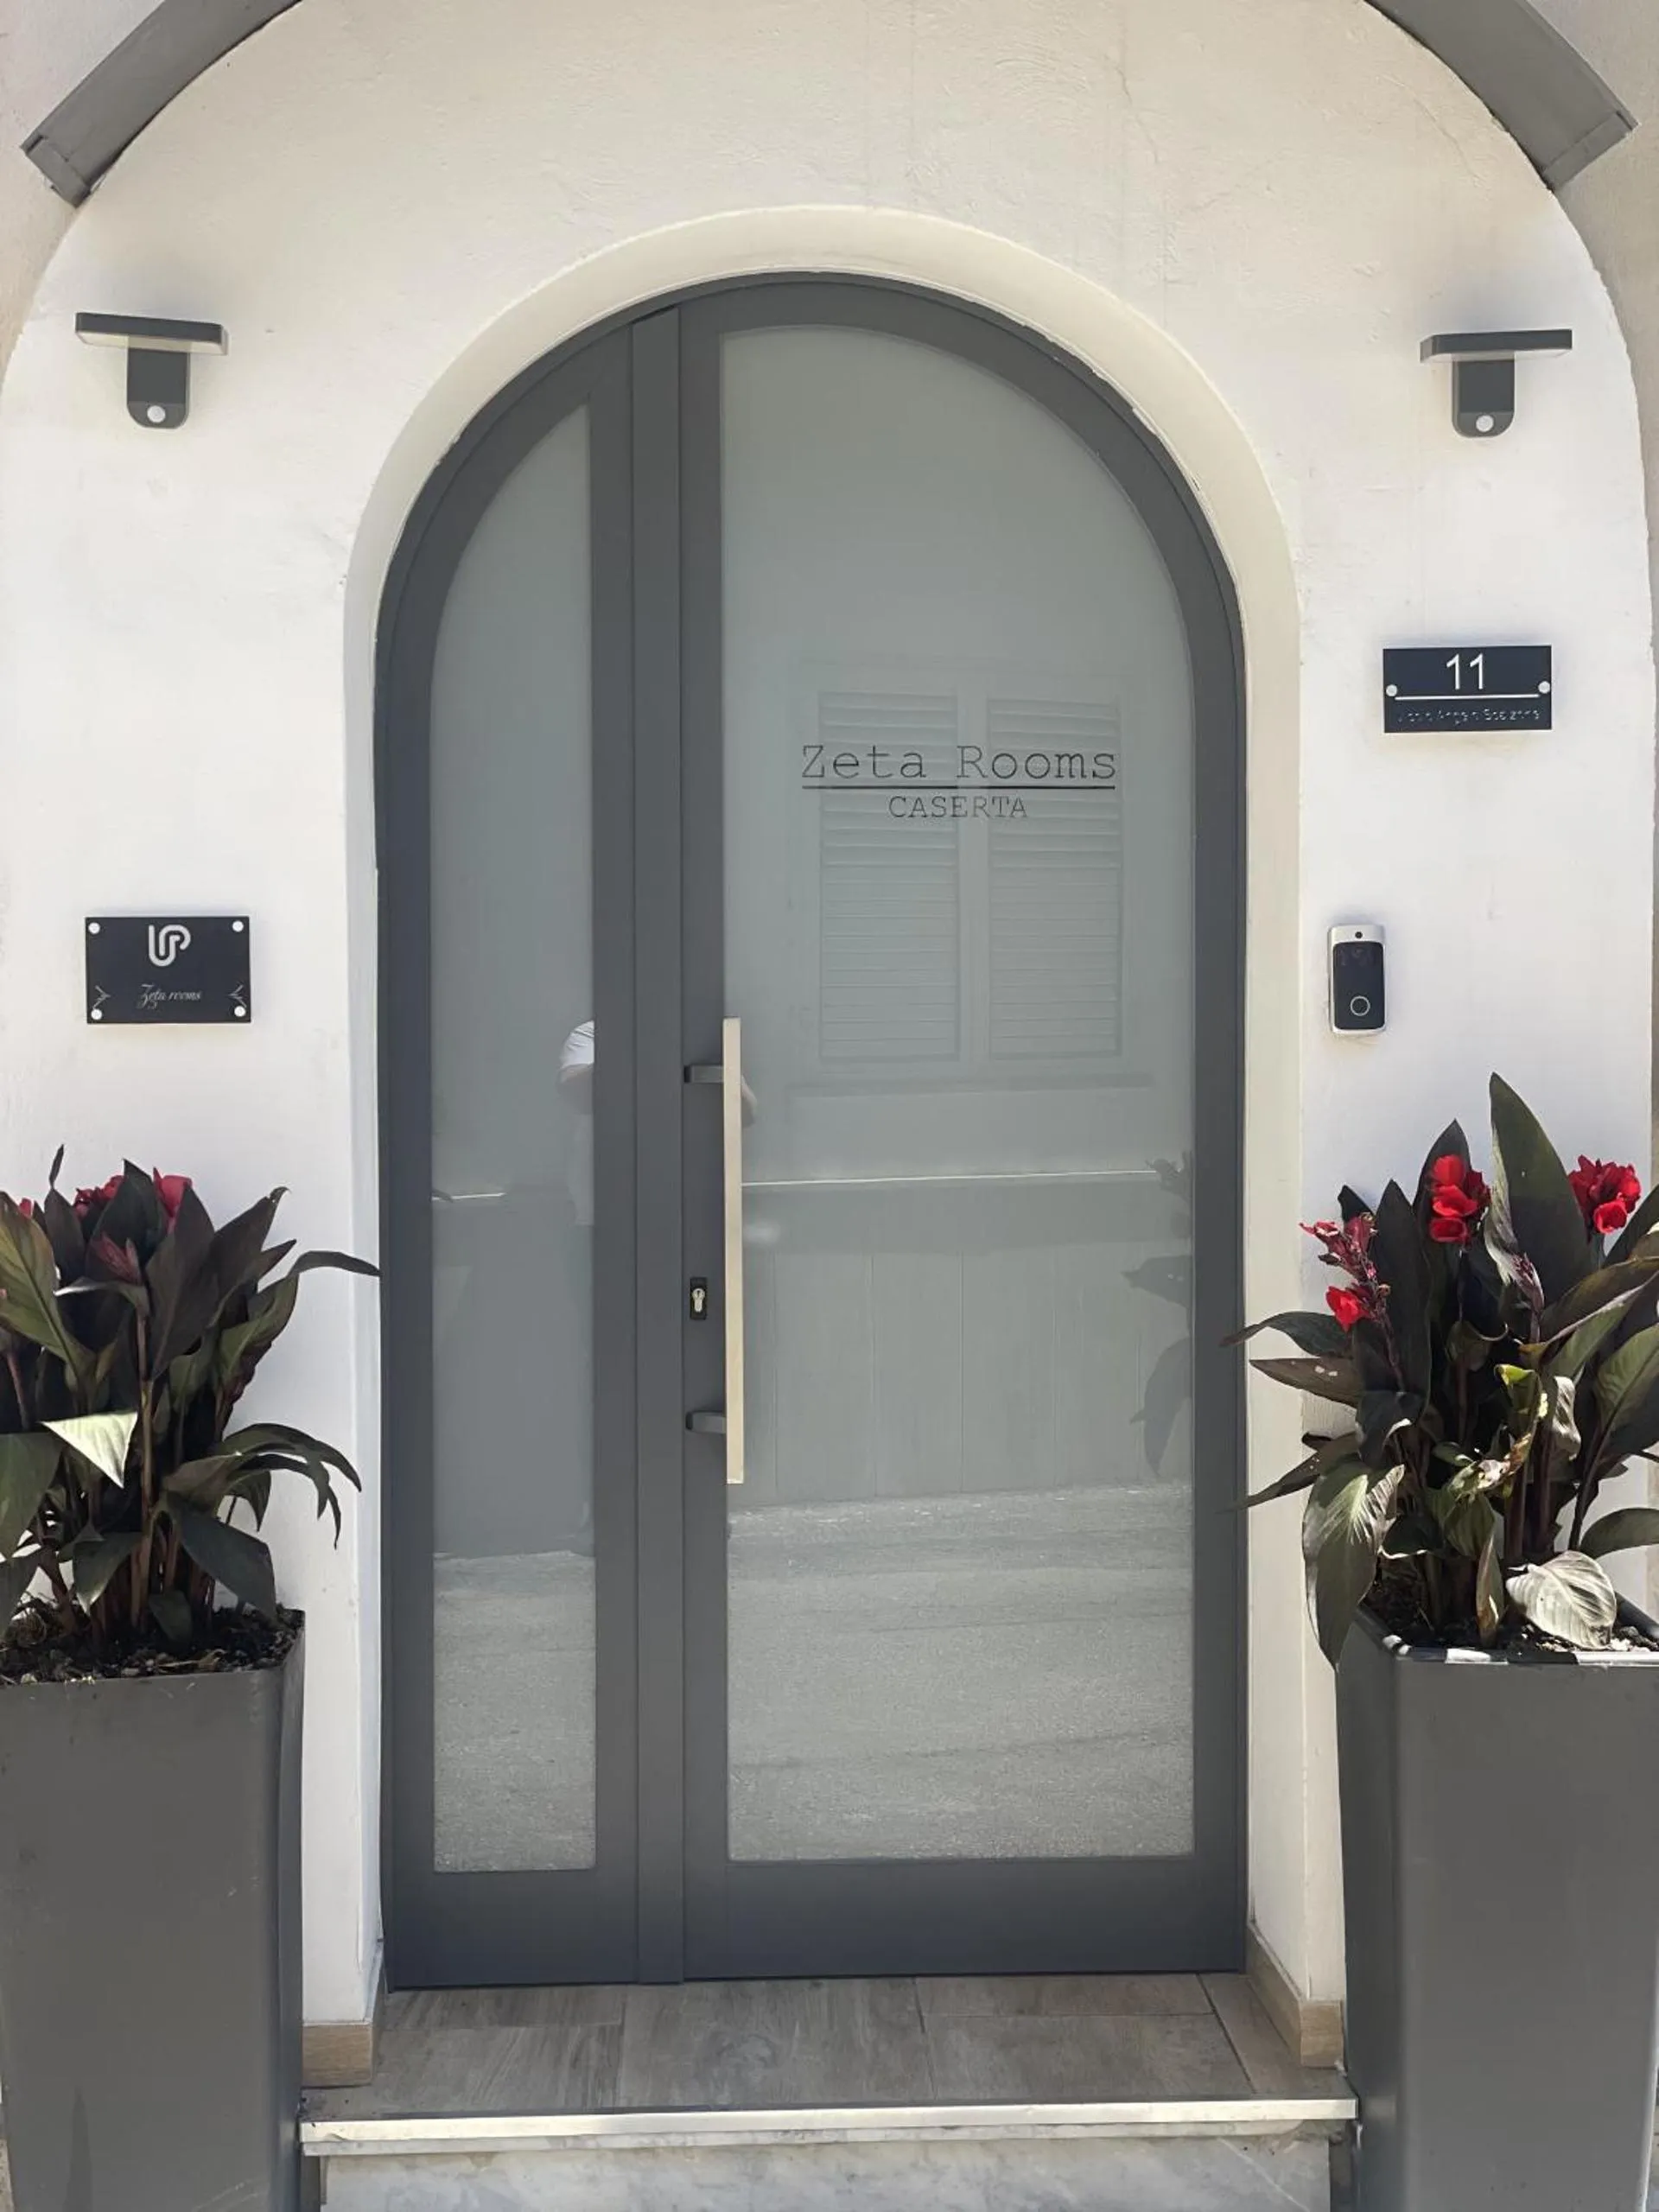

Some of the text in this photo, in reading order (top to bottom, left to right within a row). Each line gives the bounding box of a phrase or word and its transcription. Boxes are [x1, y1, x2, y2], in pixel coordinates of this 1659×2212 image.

[1446, 652, 1484, 690] 11
[801, 745, 1116, 779] Zeta Rooms
[888, 795, 1028, 819] CASERTA
